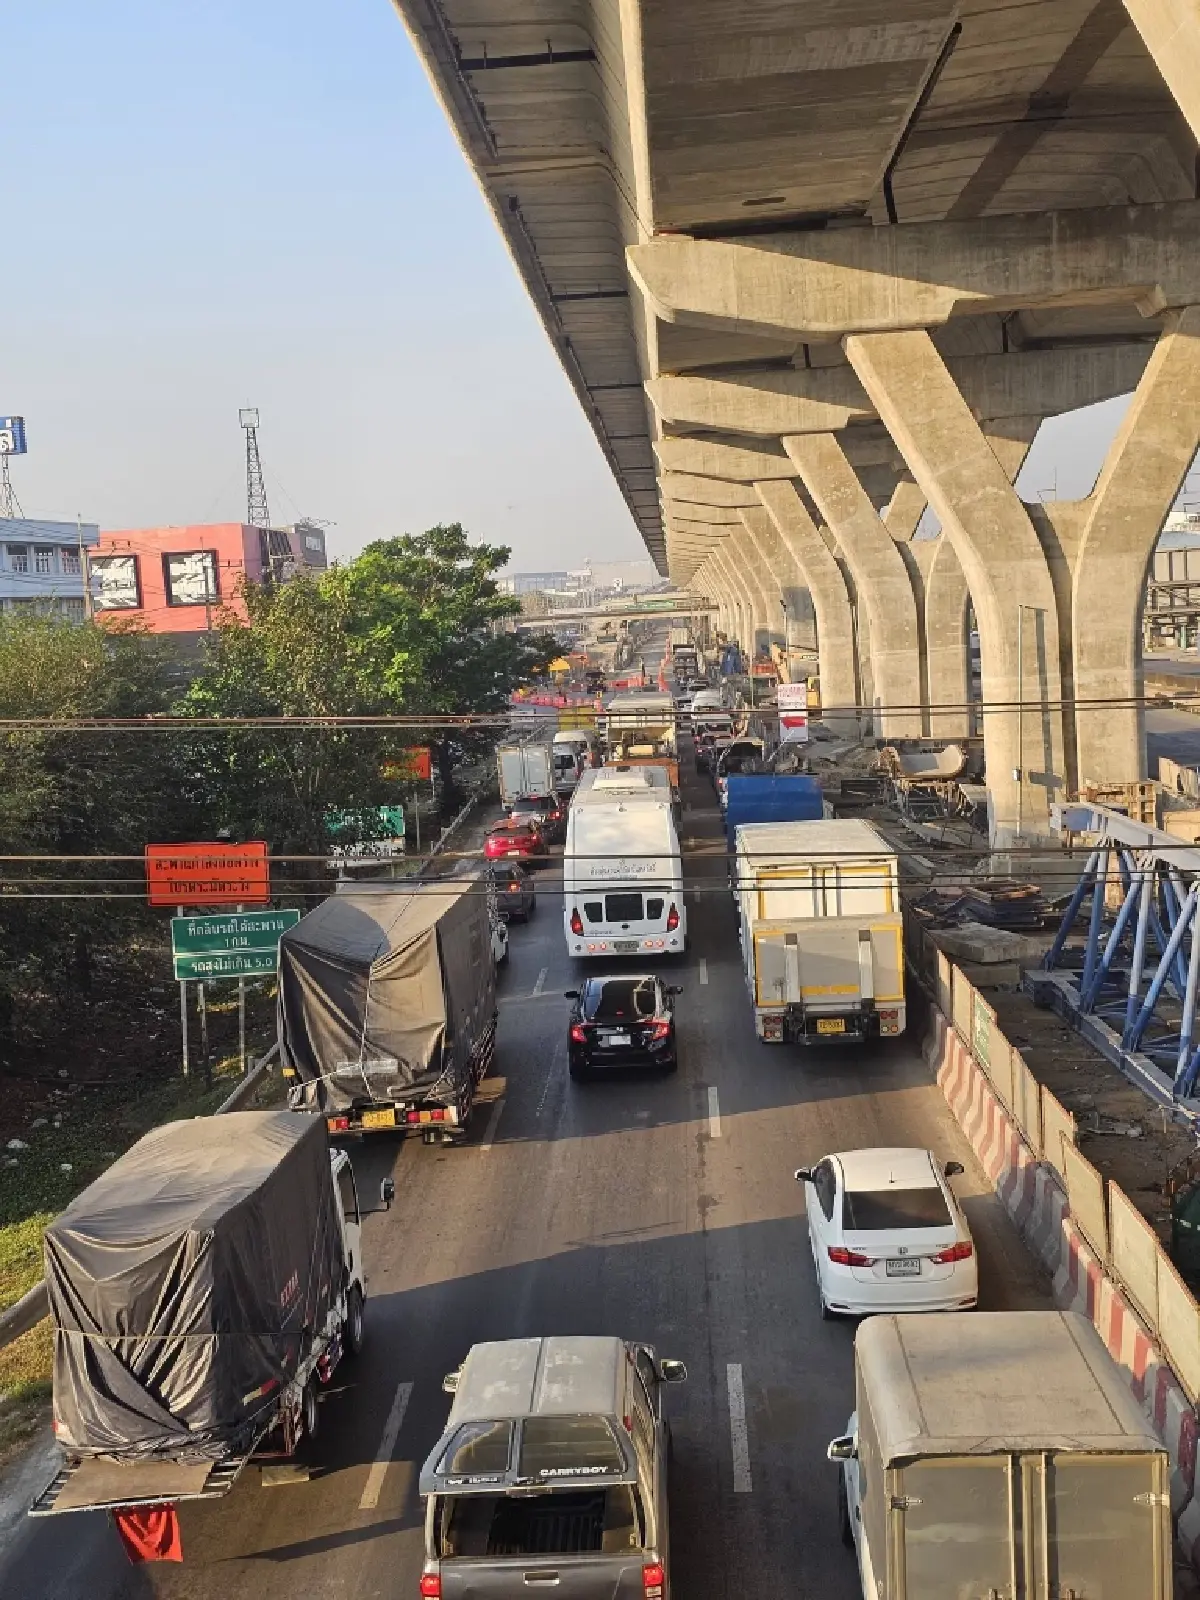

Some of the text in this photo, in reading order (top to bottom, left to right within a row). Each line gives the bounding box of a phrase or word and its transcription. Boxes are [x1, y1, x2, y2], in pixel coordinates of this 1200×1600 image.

[187, 918, 285, 937] ที่กลับรถใต้สะพาน
[191, 956, 273, 976] รถสูงไม่เกิน 5.0
[540, 1465, 609, 1477] CARRYBOY
